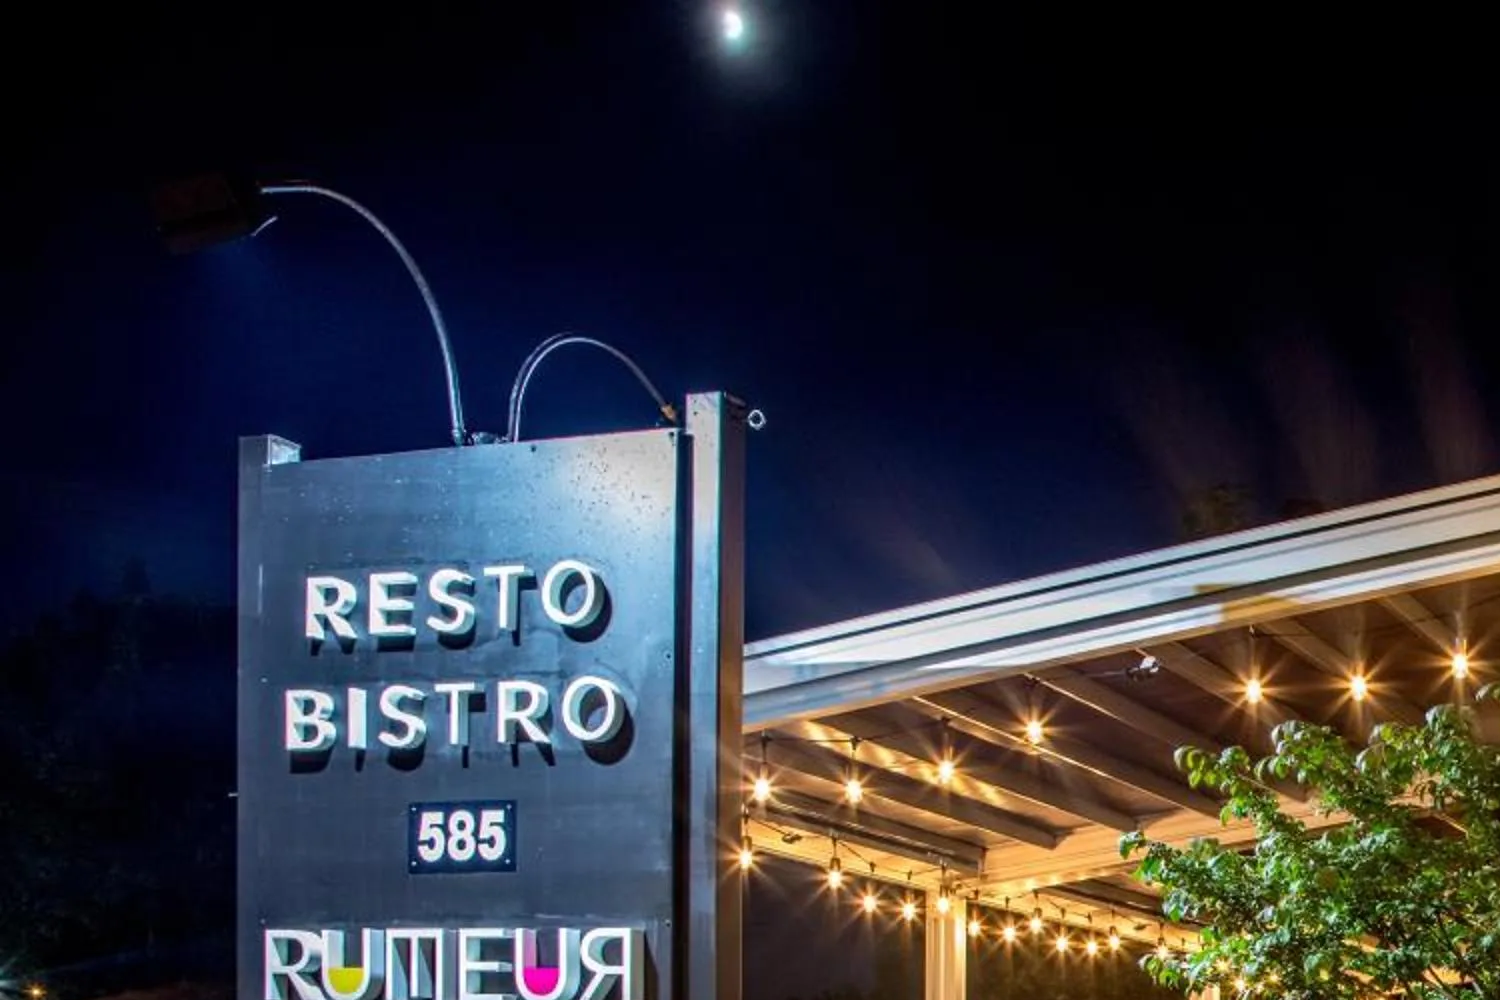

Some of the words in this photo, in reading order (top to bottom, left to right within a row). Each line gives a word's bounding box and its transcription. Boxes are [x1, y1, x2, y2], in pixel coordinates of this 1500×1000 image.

[305, 560, 606, 640] RESTO
[285, 676, 625, 751] BISTRO
[416, 809, 507, 863] 585
